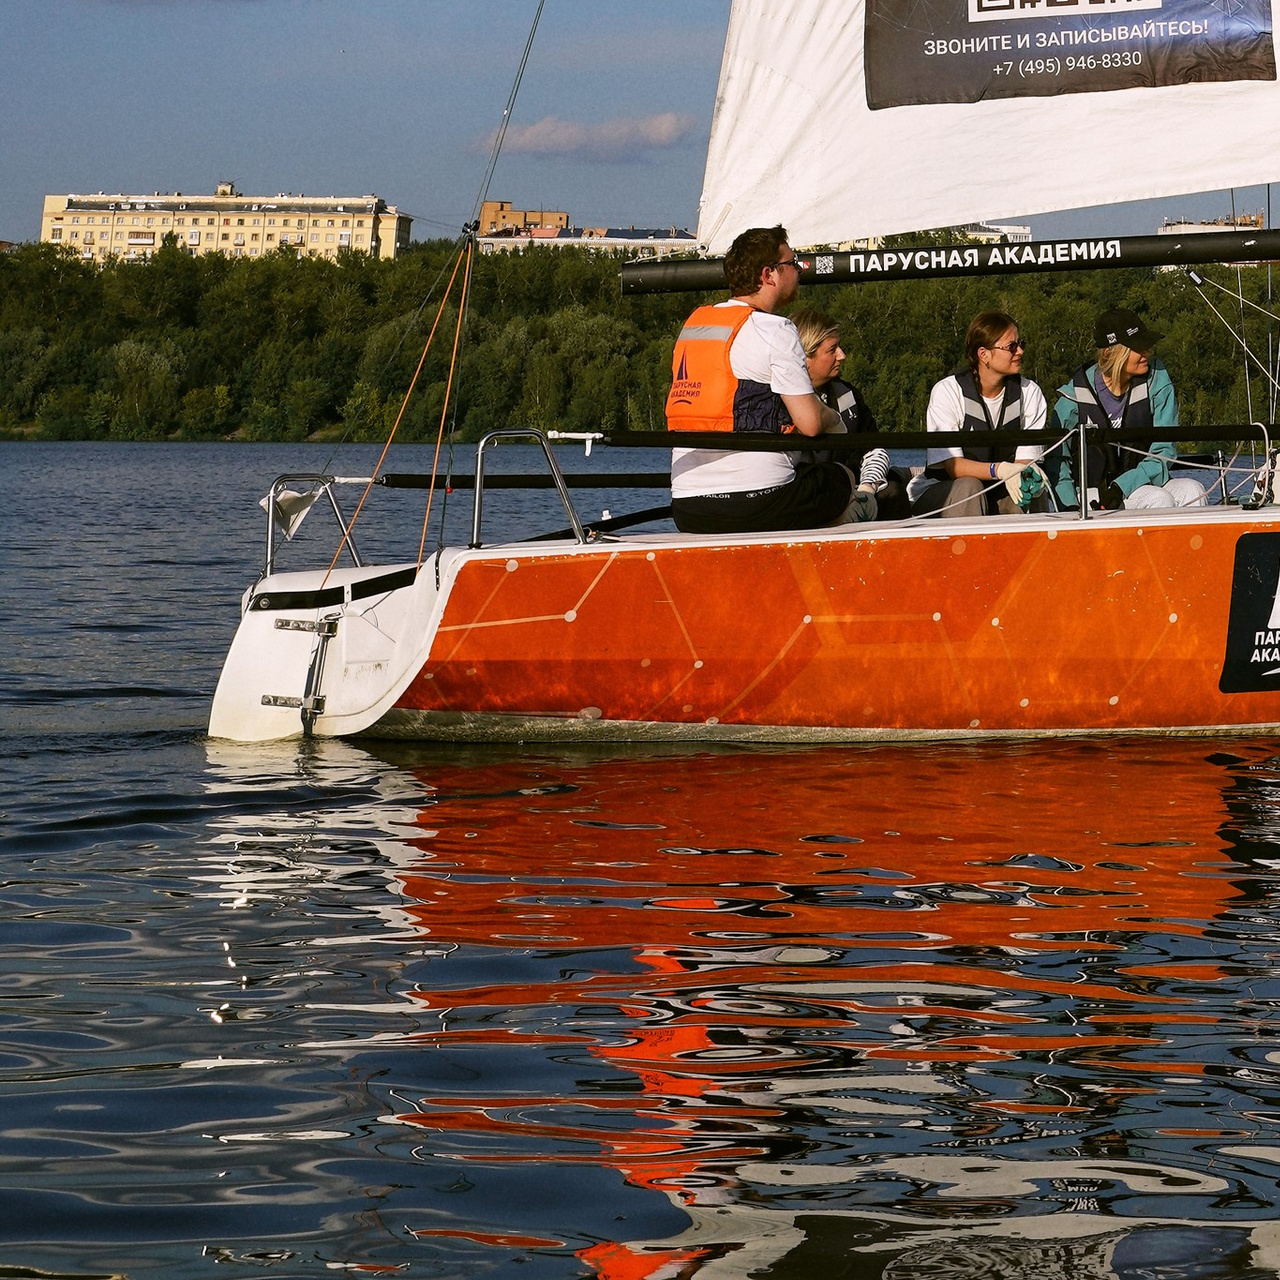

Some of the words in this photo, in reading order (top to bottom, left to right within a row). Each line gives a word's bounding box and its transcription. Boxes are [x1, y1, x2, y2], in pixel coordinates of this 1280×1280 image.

[923, 33, 1013, 57] ЗВОНИТЕ
[1016, 32, 1031, 49] И
[1034, 19, 1210, 48] ЗАПИСЫВАЙТЕСЬ!
[992, 61, 1014, 76] +7
[1018, 56, 1062, 79] (495)
[1065, 50, 1143, 72] 946-8330
[849, 248, 979, 273] ПАРУСНАЯ
[987, 239, 1122, 266] АКАДЕМИЯ
